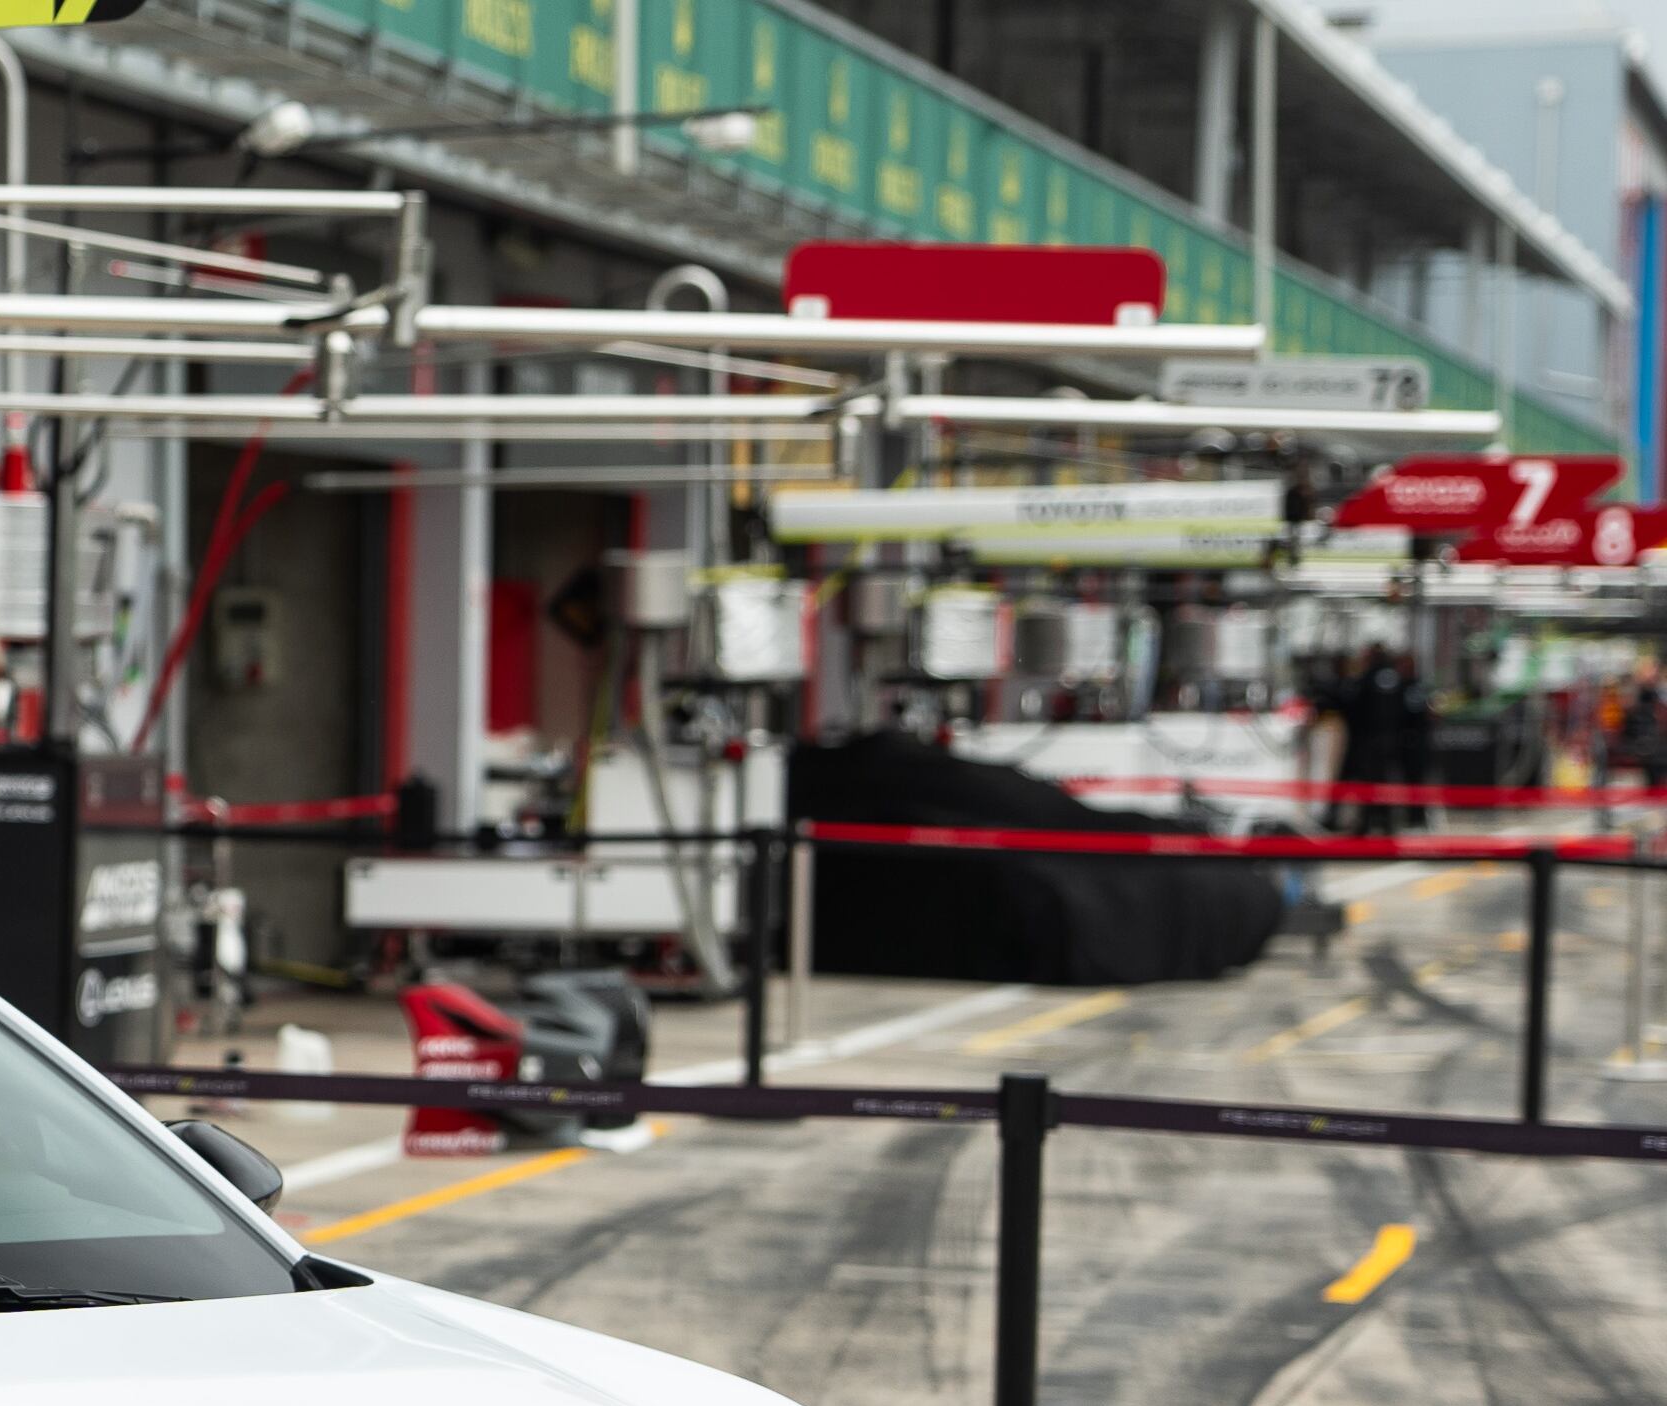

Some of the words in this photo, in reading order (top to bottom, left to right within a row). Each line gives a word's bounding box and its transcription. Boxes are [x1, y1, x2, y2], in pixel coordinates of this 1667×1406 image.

[1509, 459, 1557, 531] 7
[1592, 507, 1636, 566] 8
[1219, 1109, 1312, 1130] PEUGEOT
